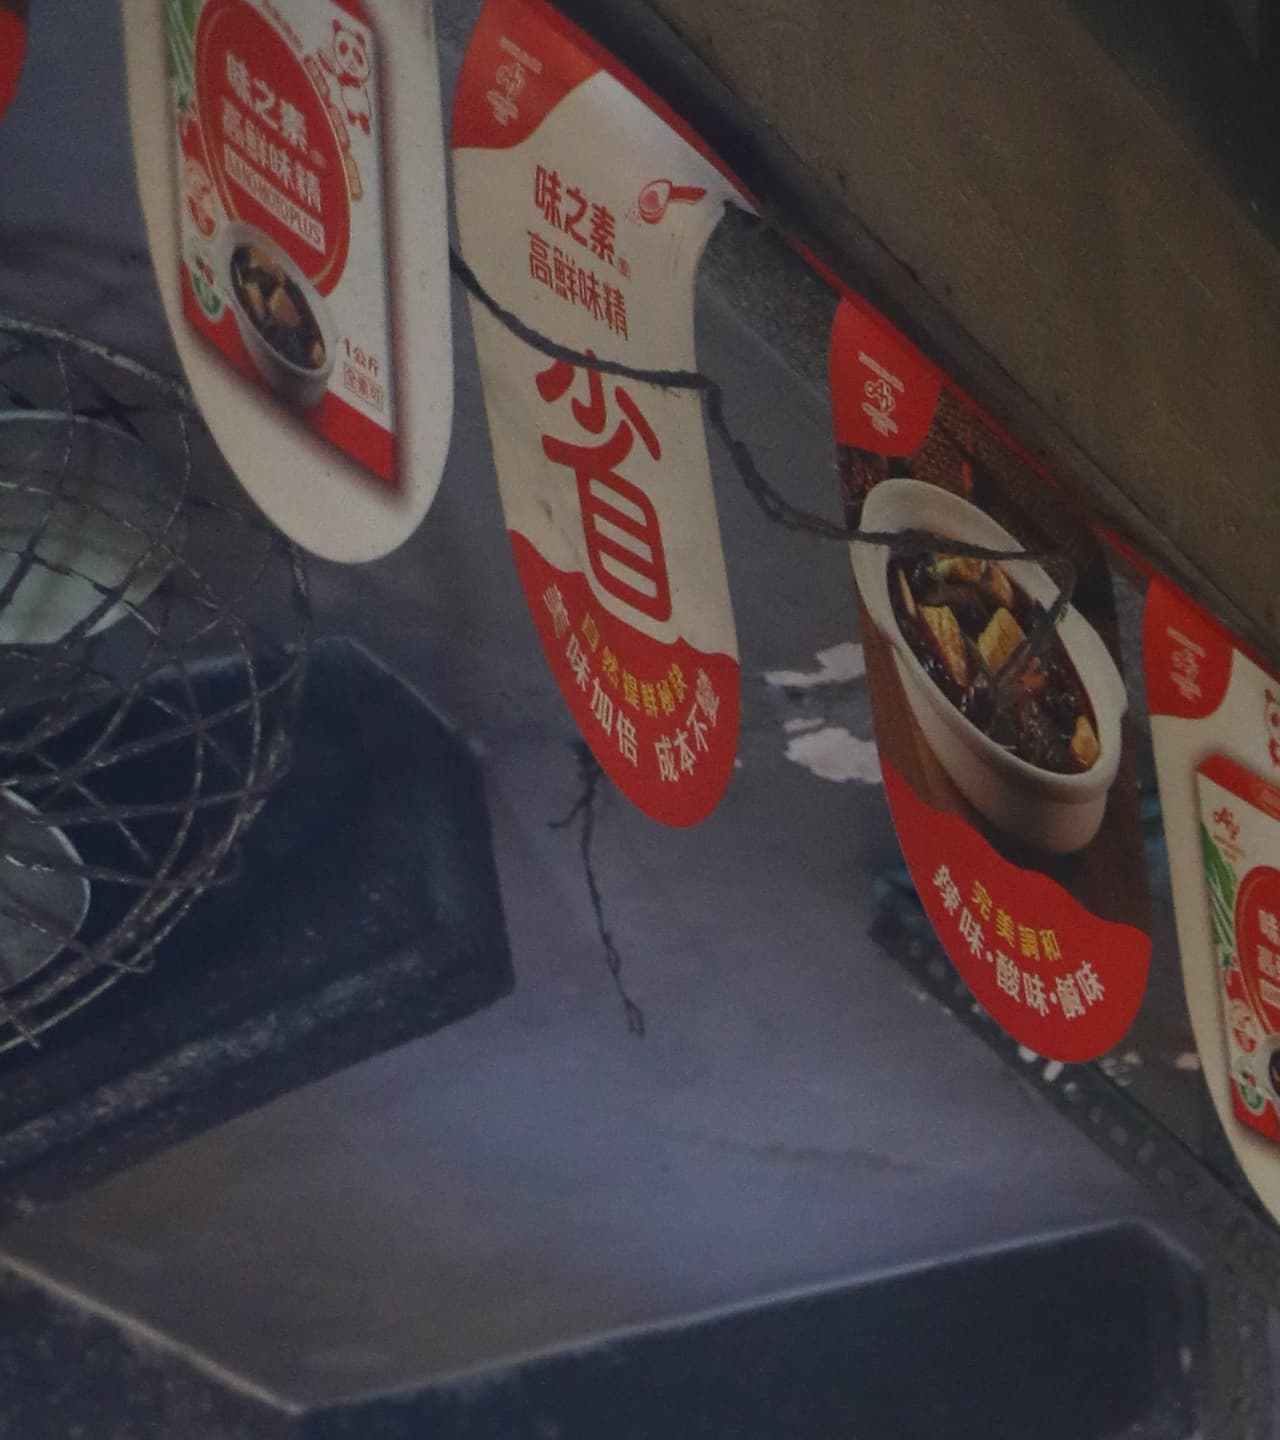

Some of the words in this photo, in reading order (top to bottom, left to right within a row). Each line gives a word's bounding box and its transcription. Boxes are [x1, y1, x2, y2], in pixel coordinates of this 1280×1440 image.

[226, 51, 308, 154] 味之素
[534, 163, 616, 267] 味之素
[527, 229, 629, 342] 高鮮味精
[535, 348, 673, 623] 省
[543, 583, 639, 768] 美味加倍
[655, 668, 721, 784] 成本不變
[971, 878, 1062, 962] 完美調和
